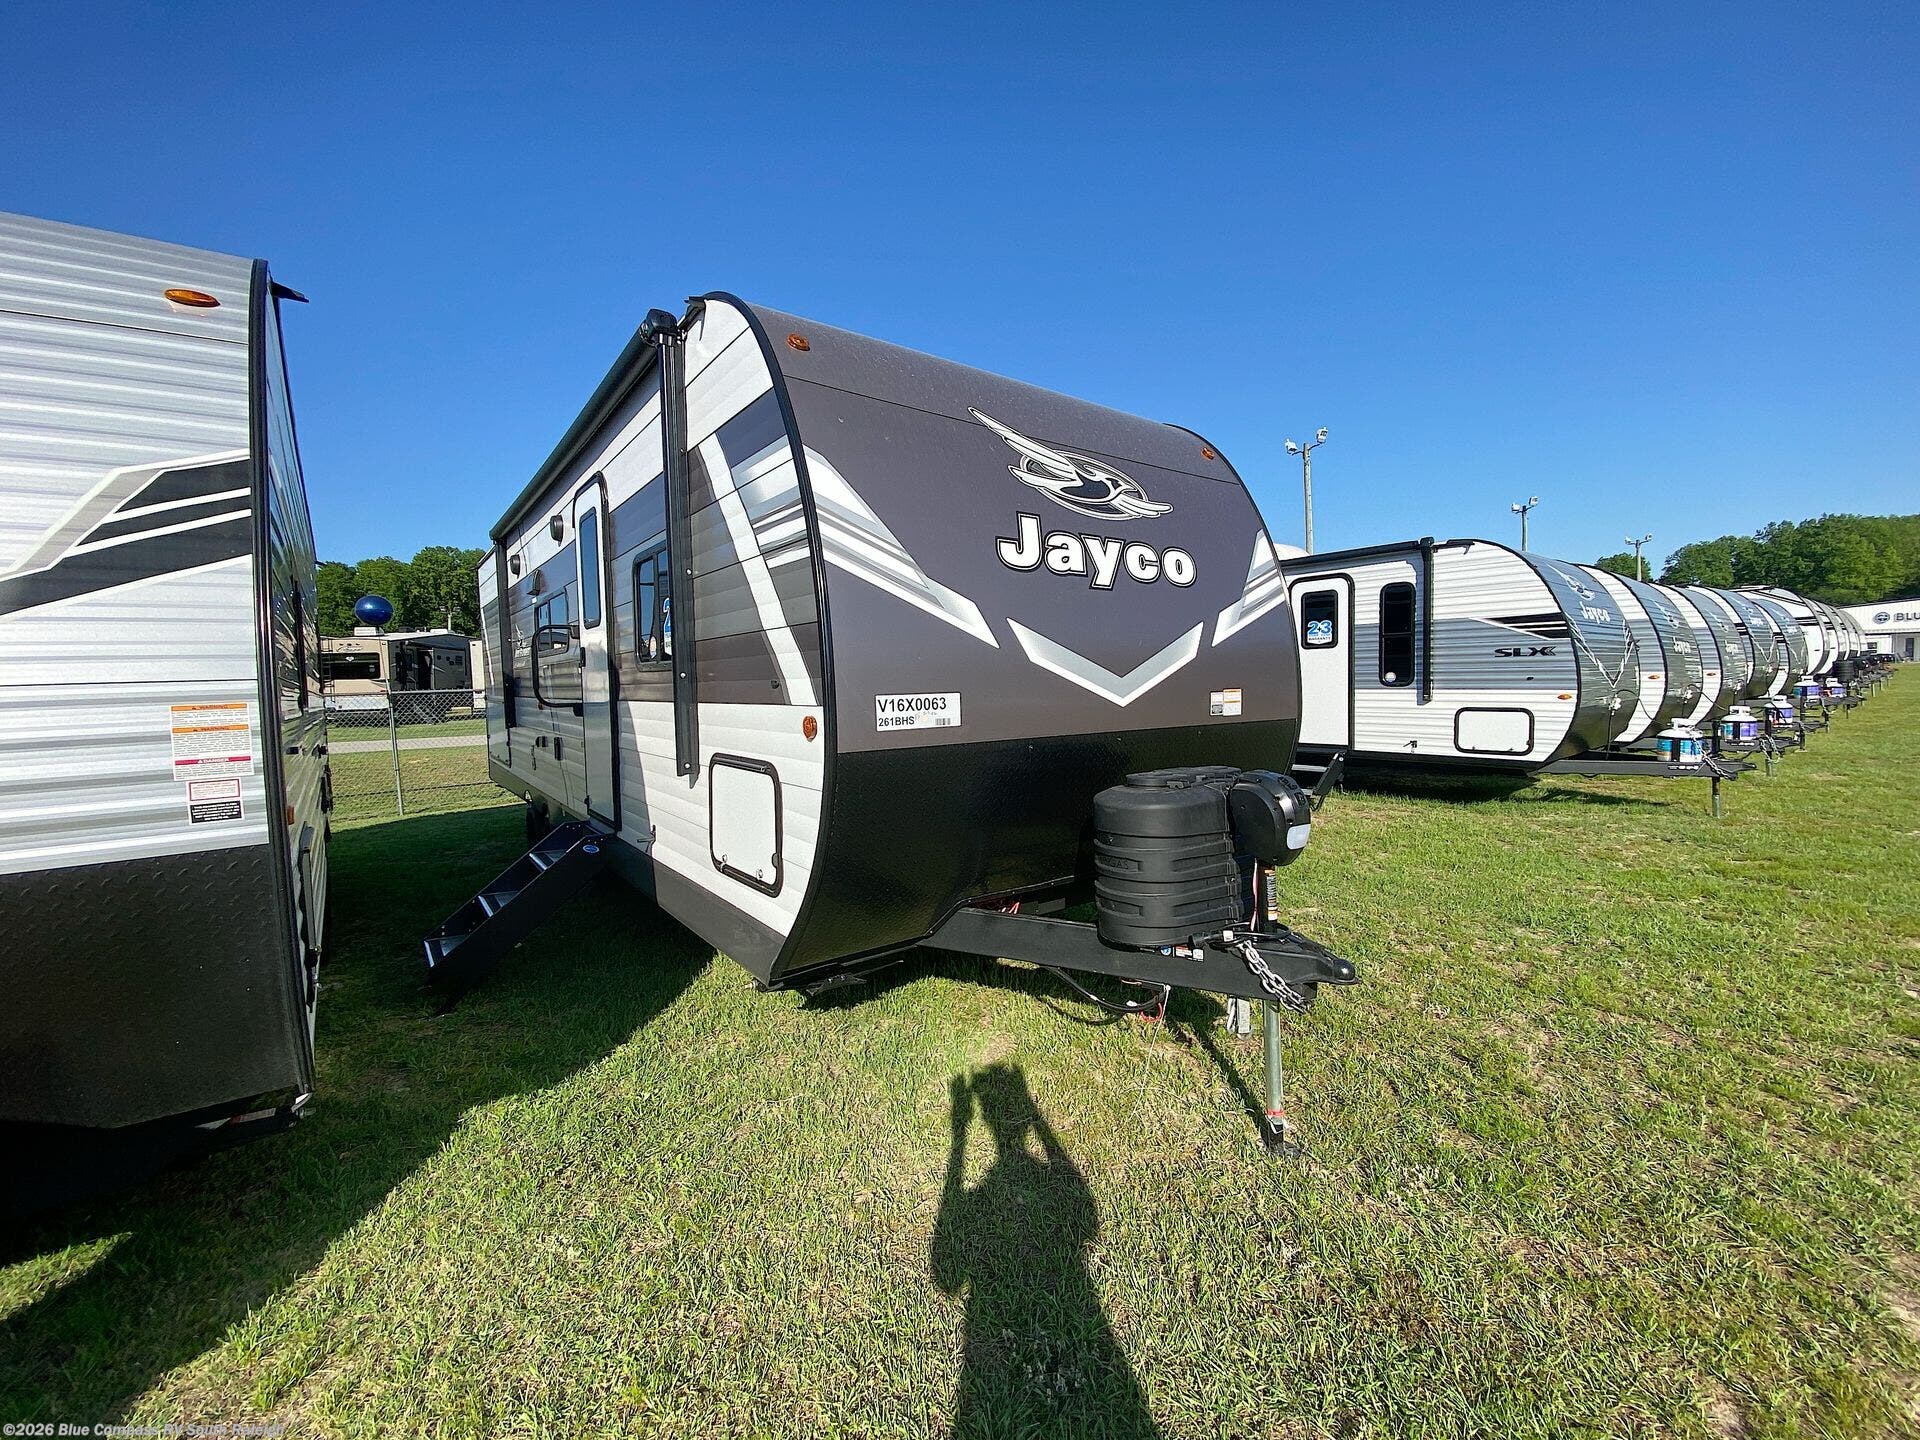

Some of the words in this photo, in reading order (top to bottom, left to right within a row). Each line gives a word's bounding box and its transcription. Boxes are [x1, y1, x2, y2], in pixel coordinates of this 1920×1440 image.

[995, 511, 1197, 590] Jayco
[1579, 601, 1611, 624] Jayco
[877, 697, 947, 713] V16X0063
[878, 716, 915, 727] 261BHS
